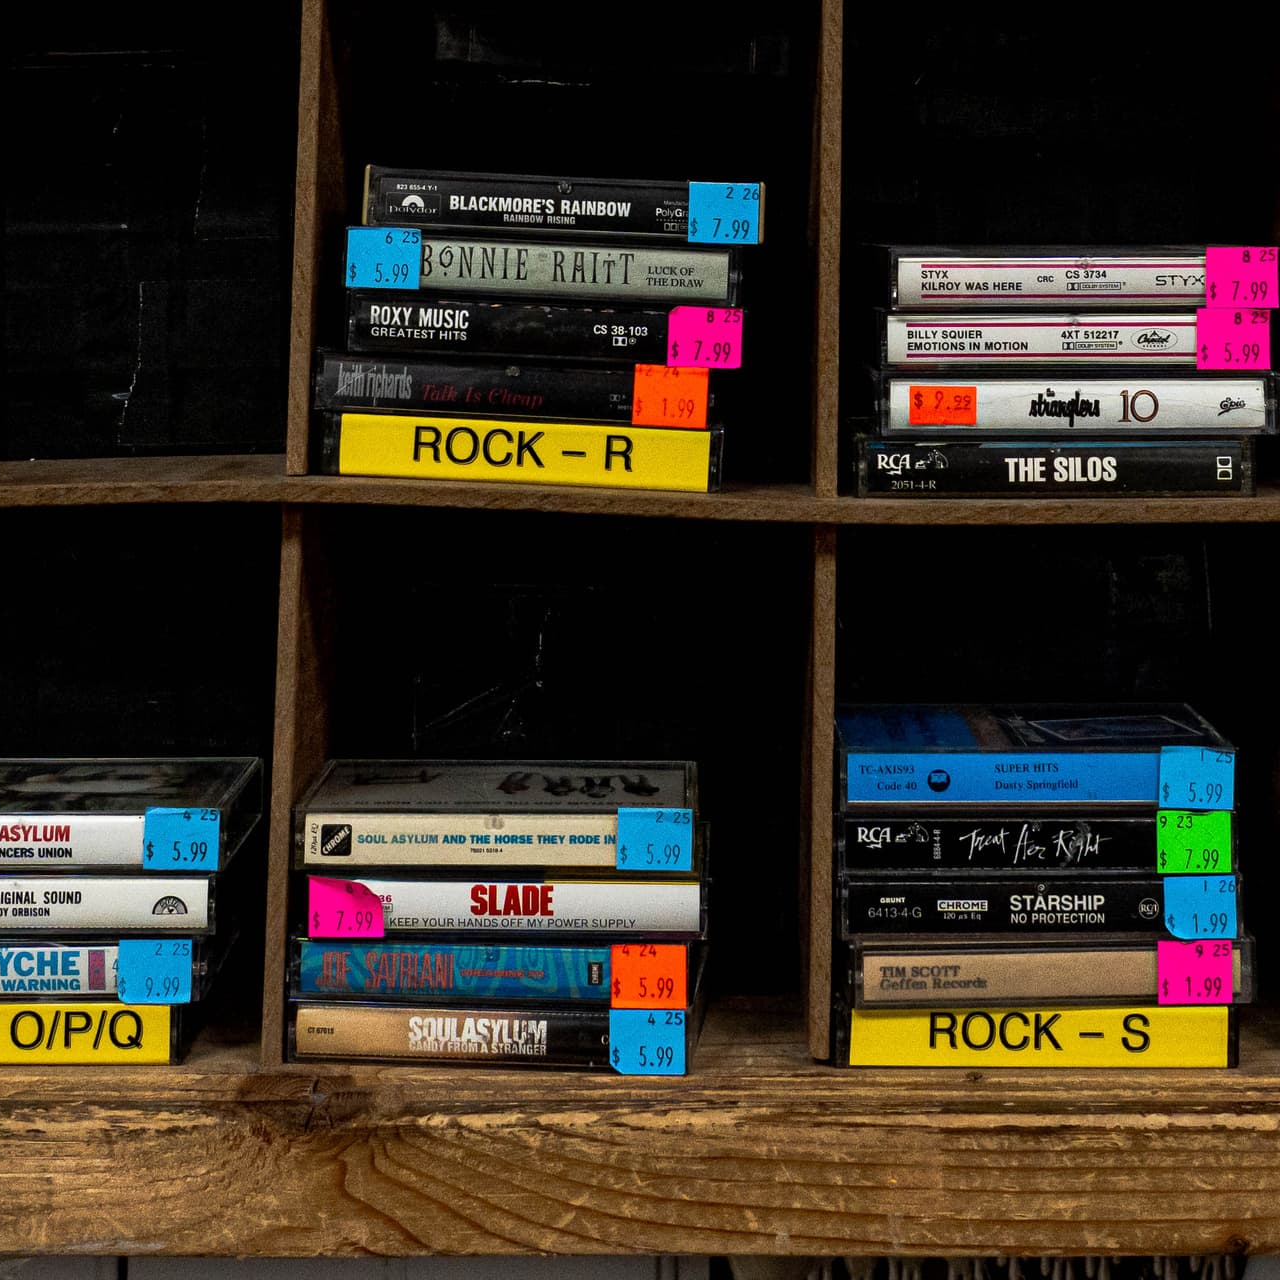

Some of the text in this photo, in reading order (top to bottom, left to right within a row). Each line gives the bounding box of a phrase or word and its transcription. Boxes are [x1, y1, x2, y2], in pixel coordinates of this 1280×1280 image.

[449, 194, 631, 218] BLACKMORE'S RAINBOW
[921, 271, 949, 280] STYX
[921, 282, 1022, 291] KILROY WAS HERE
[370, 306, 470, 330] ROXY MUSIC
[907, 330, 982, 340] BILLY SQUIER
[413, 425, 633, 472] ROCK R
[1004, 457, 1117, 483] THE SILOS
[12, 908, 50, 917] ORBISON
[470, 885, 554, 916] SLADE
[1009, 895, 1105, 911] STARSHIP
[1011, 913, 1105, 923] NO PROTECTION
[10, 1010, 144, 1050] O/P/Q
[929, 1012, 1150, 1052] ROCK S
